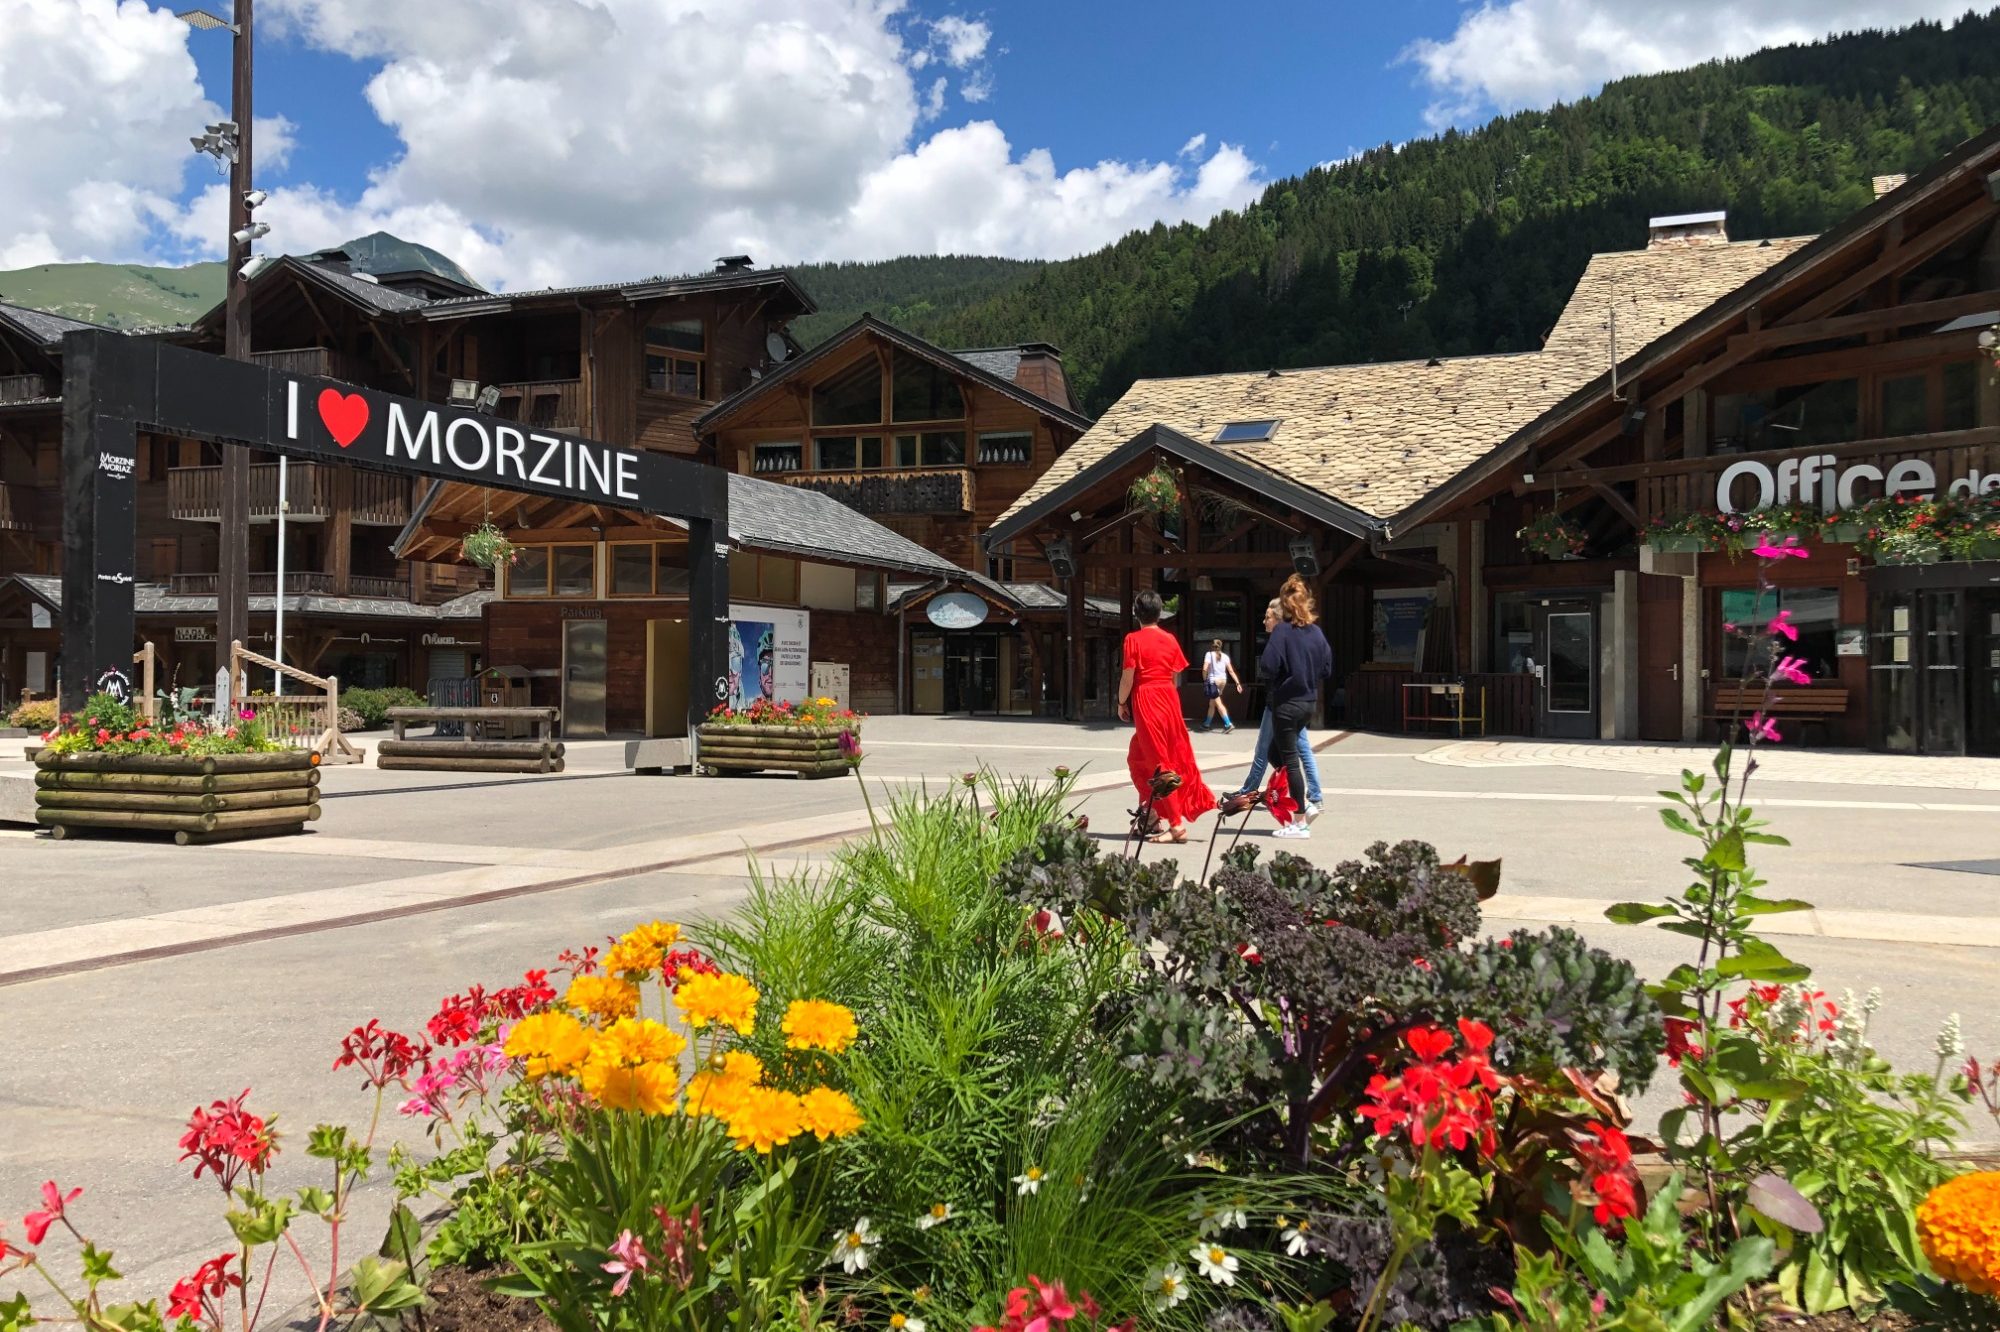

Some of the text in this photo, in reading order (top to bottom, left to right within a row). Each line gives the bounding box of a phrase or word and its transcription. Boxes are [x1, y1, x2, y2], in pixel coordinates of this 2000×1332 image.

[287, 380, 640, 501] I MORZINE
[1716, 454, 1936, 518] Office
[560, 607, 602, 619] Parking
